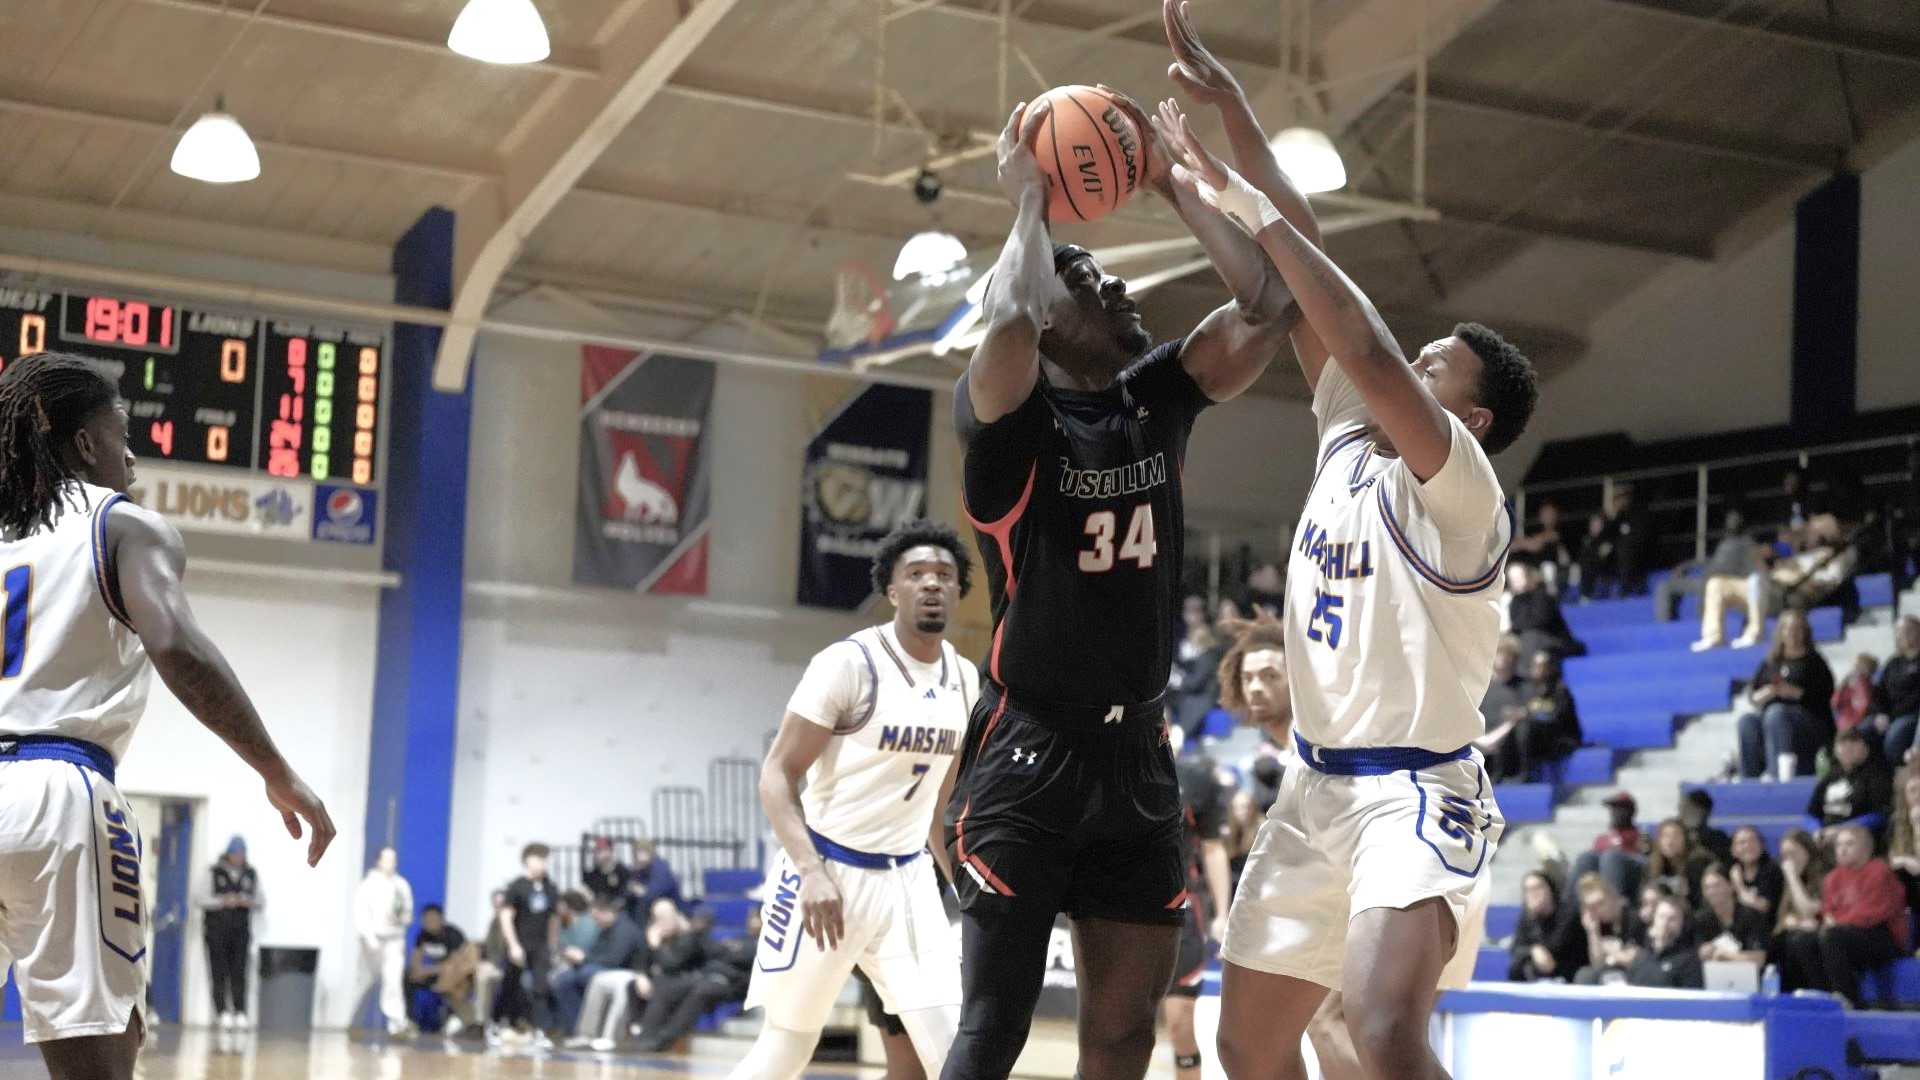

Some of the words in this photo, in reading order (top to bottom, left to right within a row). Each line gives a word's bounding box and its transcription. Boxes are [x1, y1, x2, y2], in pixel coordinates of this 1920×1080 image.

[19, 313, 46, 356] 0
[144, 356, 155, 391] 1
[220, 339, 247, 383] 0
[150, 420, 174, 457] 4
[206, 424, 231, 461] 0
[157, 480, 250, 522] LIONS
[1077, 501, 1157, 574] 34
[0, 561, 34, 681] 1
[1306, 586, 1344, 651] 25
[903, 763, 931, 801] 7
